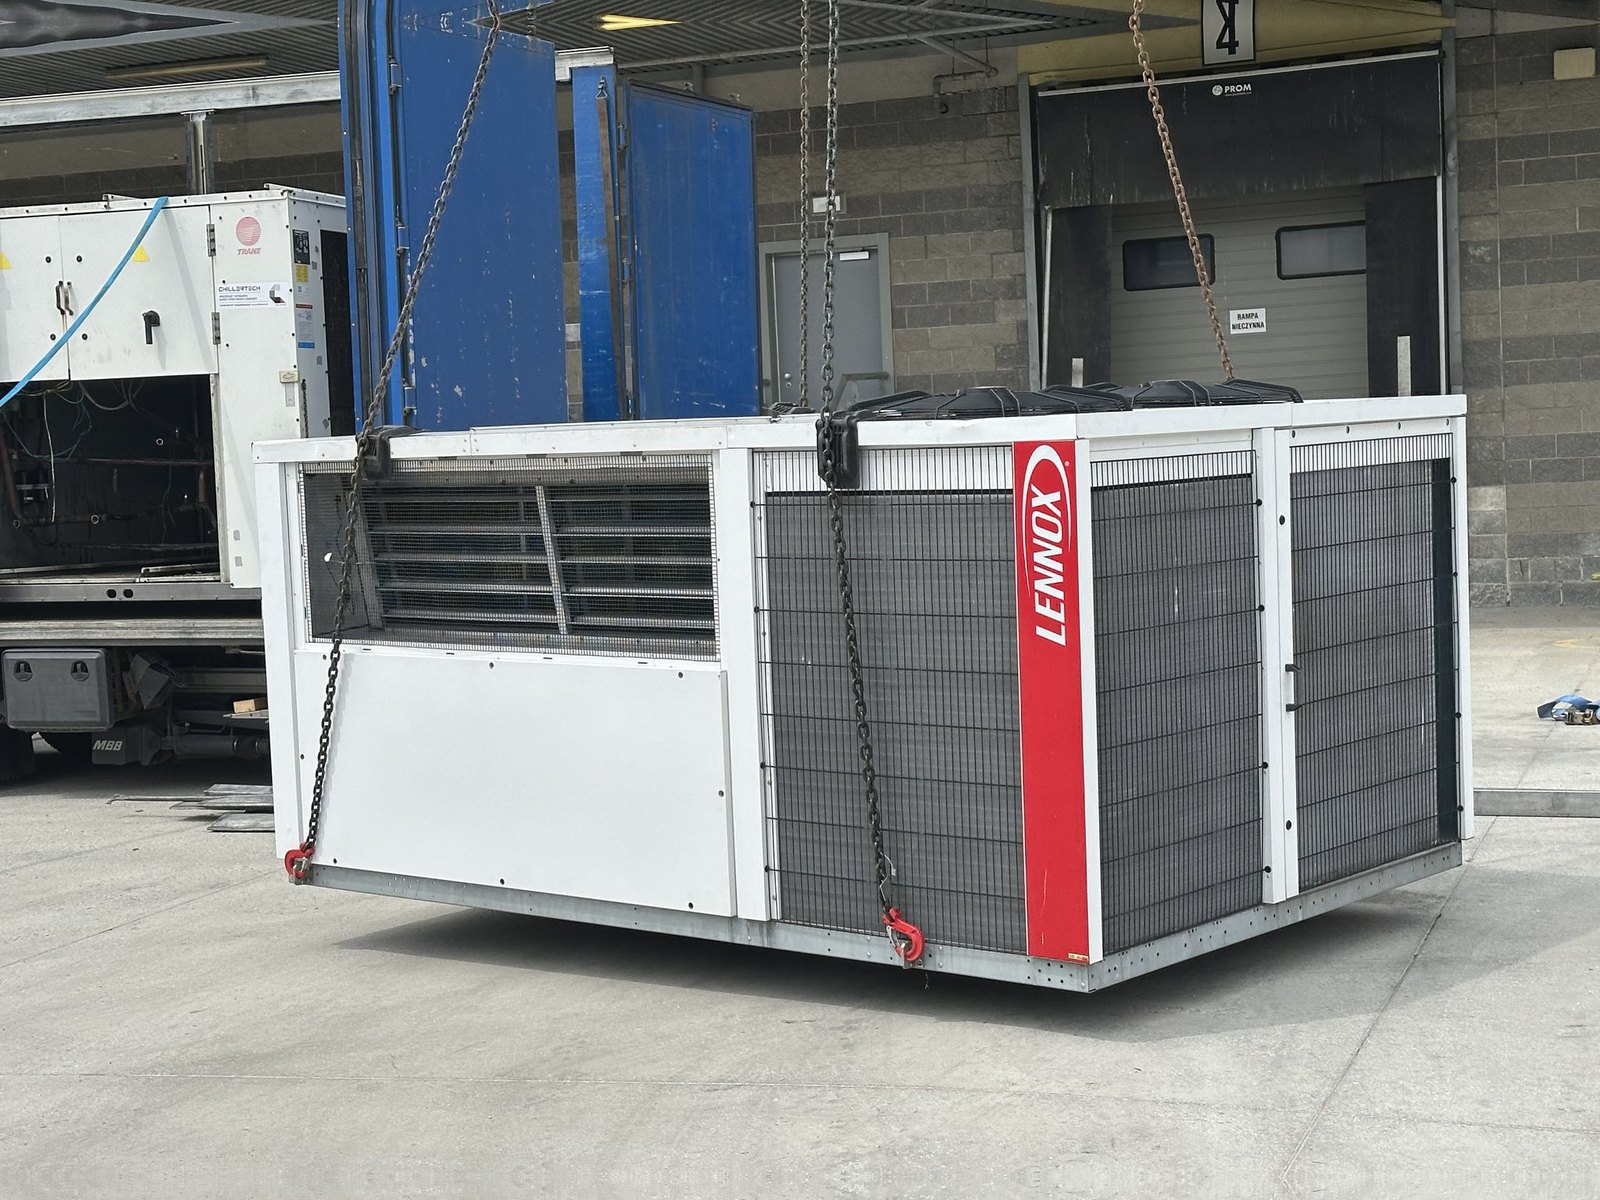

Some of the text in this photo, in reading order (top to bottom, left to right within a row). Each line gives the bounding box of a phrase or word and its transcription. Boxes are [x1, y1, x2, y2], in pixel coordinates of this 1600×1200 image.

[1224, 83, 1252, 93] PROM
[237, 247, 262, 255] TRANE
[1237, 312, 1259, 320] RAMPA
[1231, 321, 1265, 330] NIECZYNNA
[1030, 483, 1067, 647] LENNOX
[92, 739, 123, 751] MBB
